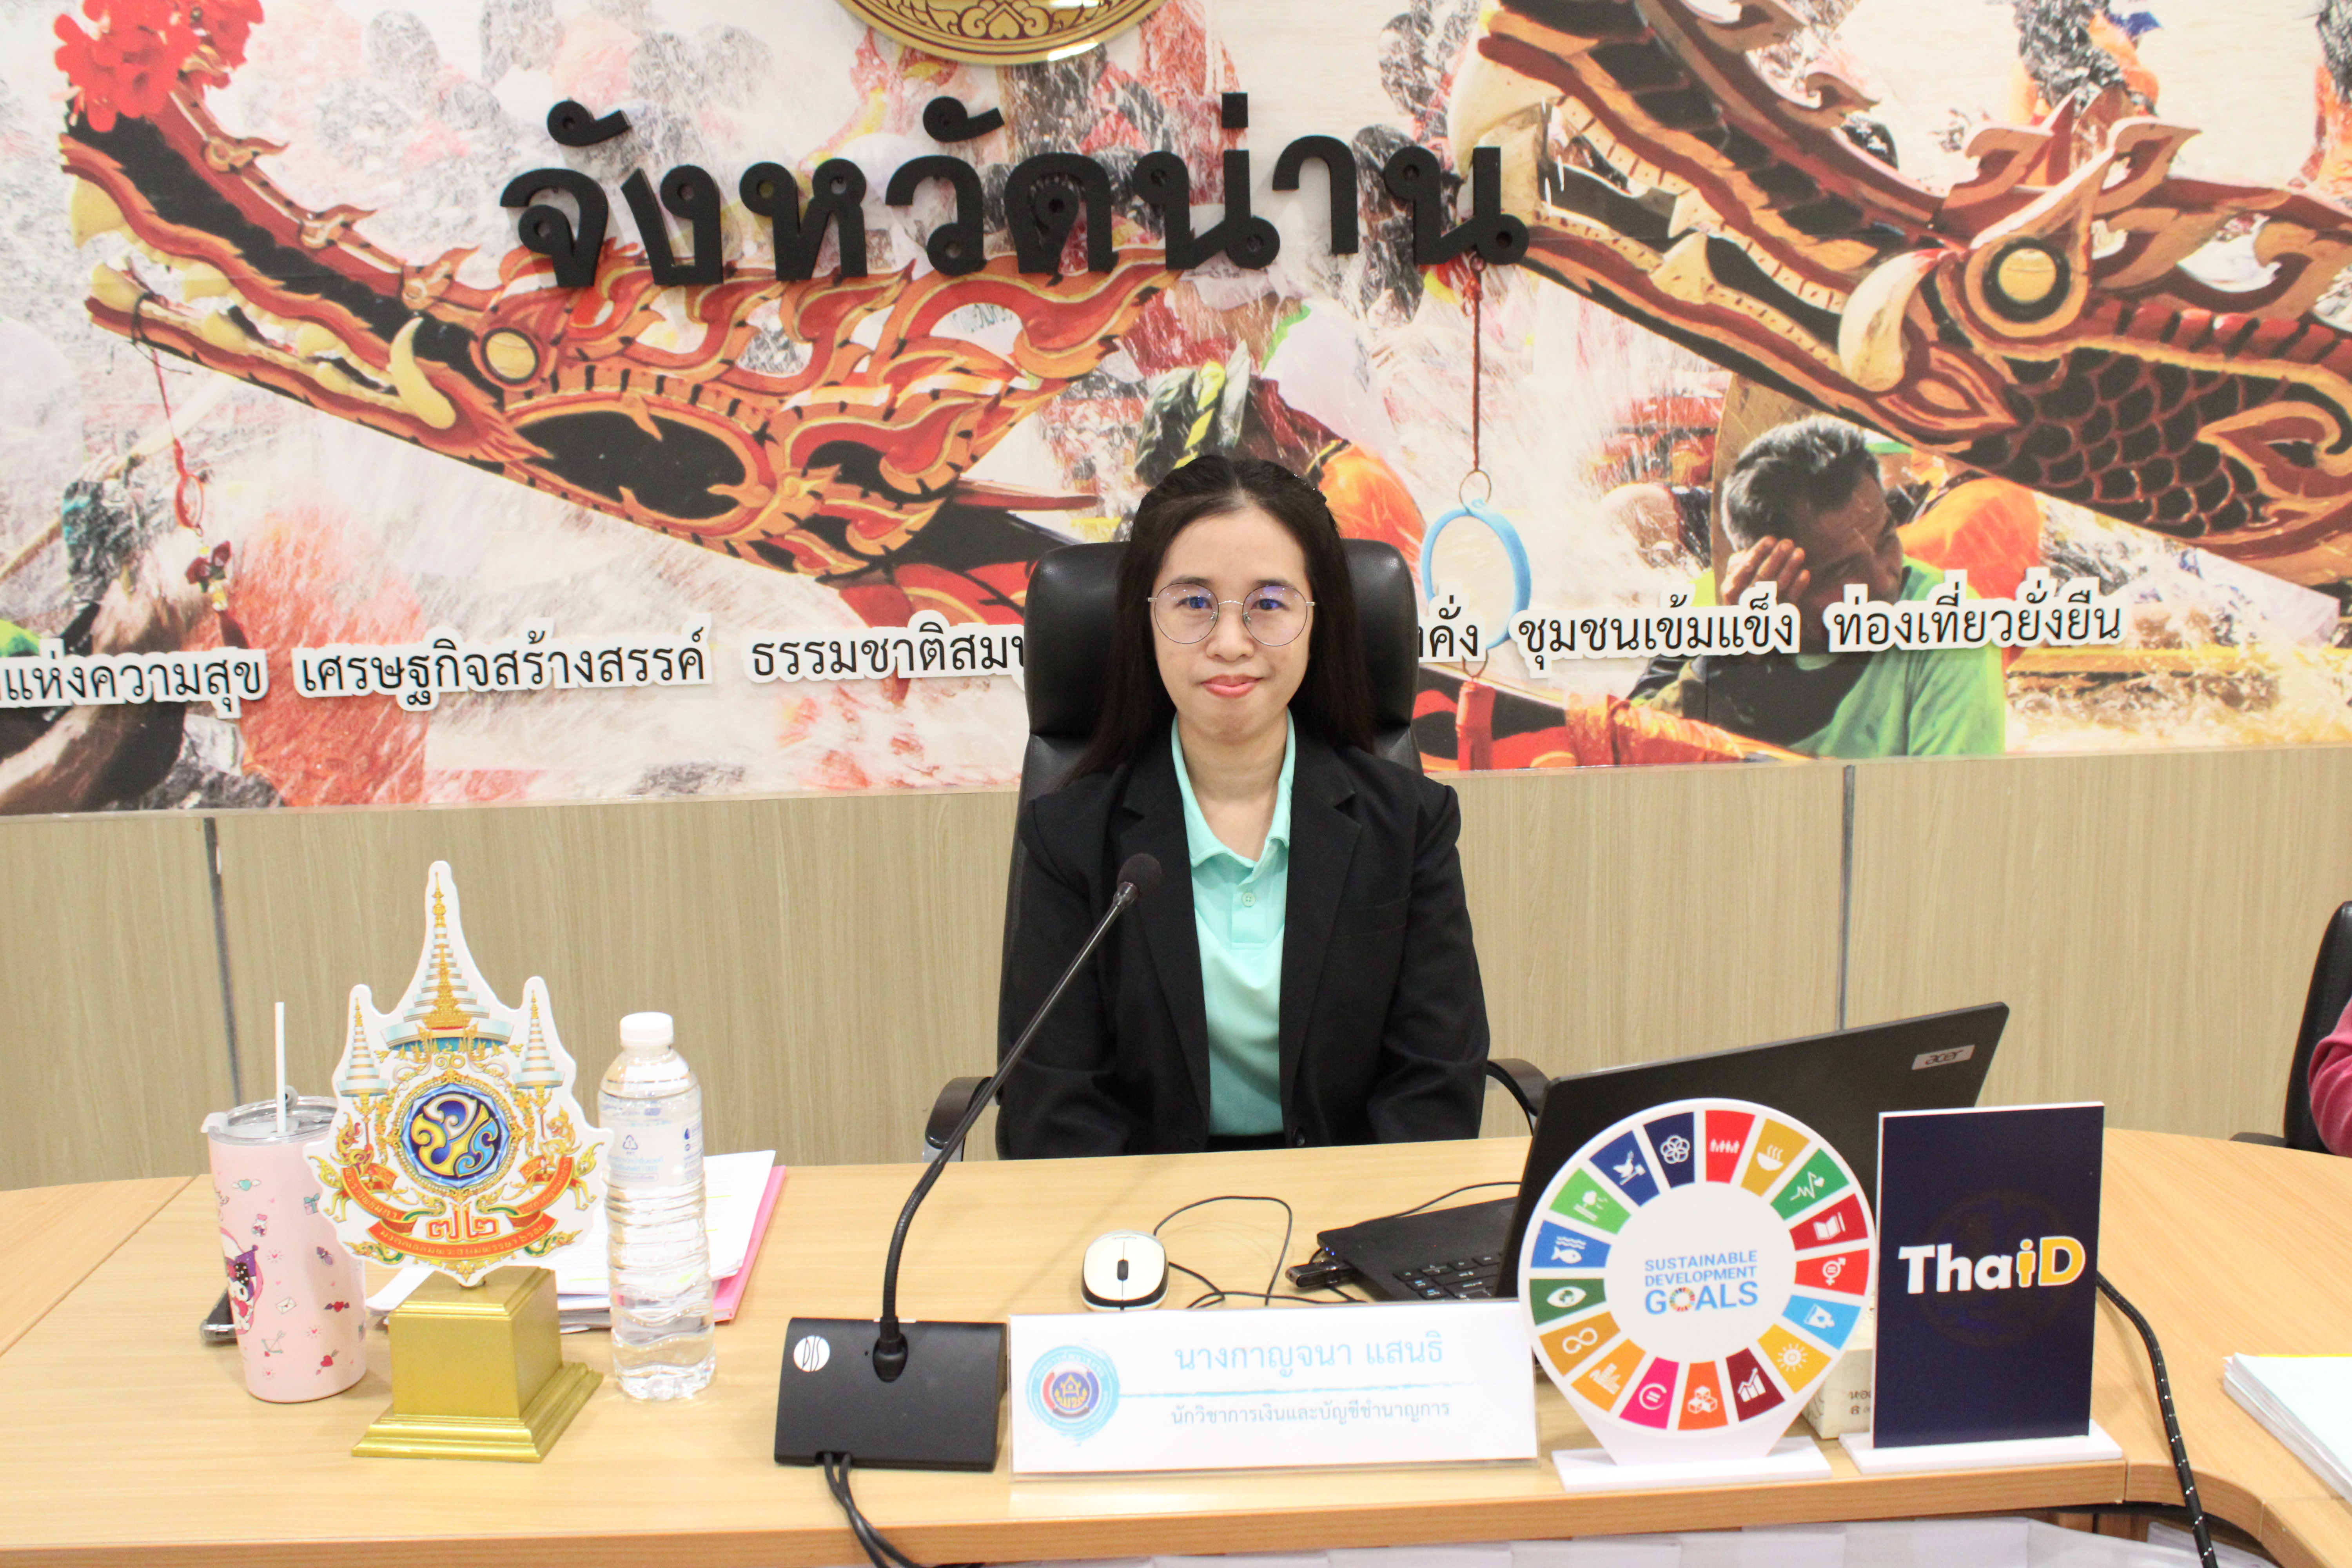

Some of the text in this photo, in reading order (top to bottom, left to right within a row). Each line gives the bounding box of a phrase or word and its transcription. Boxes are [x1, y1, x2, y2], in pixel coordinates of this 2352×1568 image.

[499, 92, 1529, 287] จังหวัดน่าน
[302, 626, 704, 705] เศรษฐกิจสร้างสรรค์
[1518, 592, 1793, 671] ชุมชนเข้มแข็ง
[1834, 579, 2122, 645] ท่องเที่ยวยั่งยืน
[1925, 1050, 1964, 1065] acer
[1645, 1250, 1757, 1272] SUSTAINABLE
[1645, 1265, 1756, 1287] DEVELOPMENT
[1898, 1236, 2086, 1294] ThaiD
[1645, 1281, 1758, 1315] GOALS
[1175, 1330, 1443, 1378] นางกาญจนา แสนธิ
[1171, 1400, 1450, 1426] นักวิชาการเงินและบัญชีชำนาญการ
